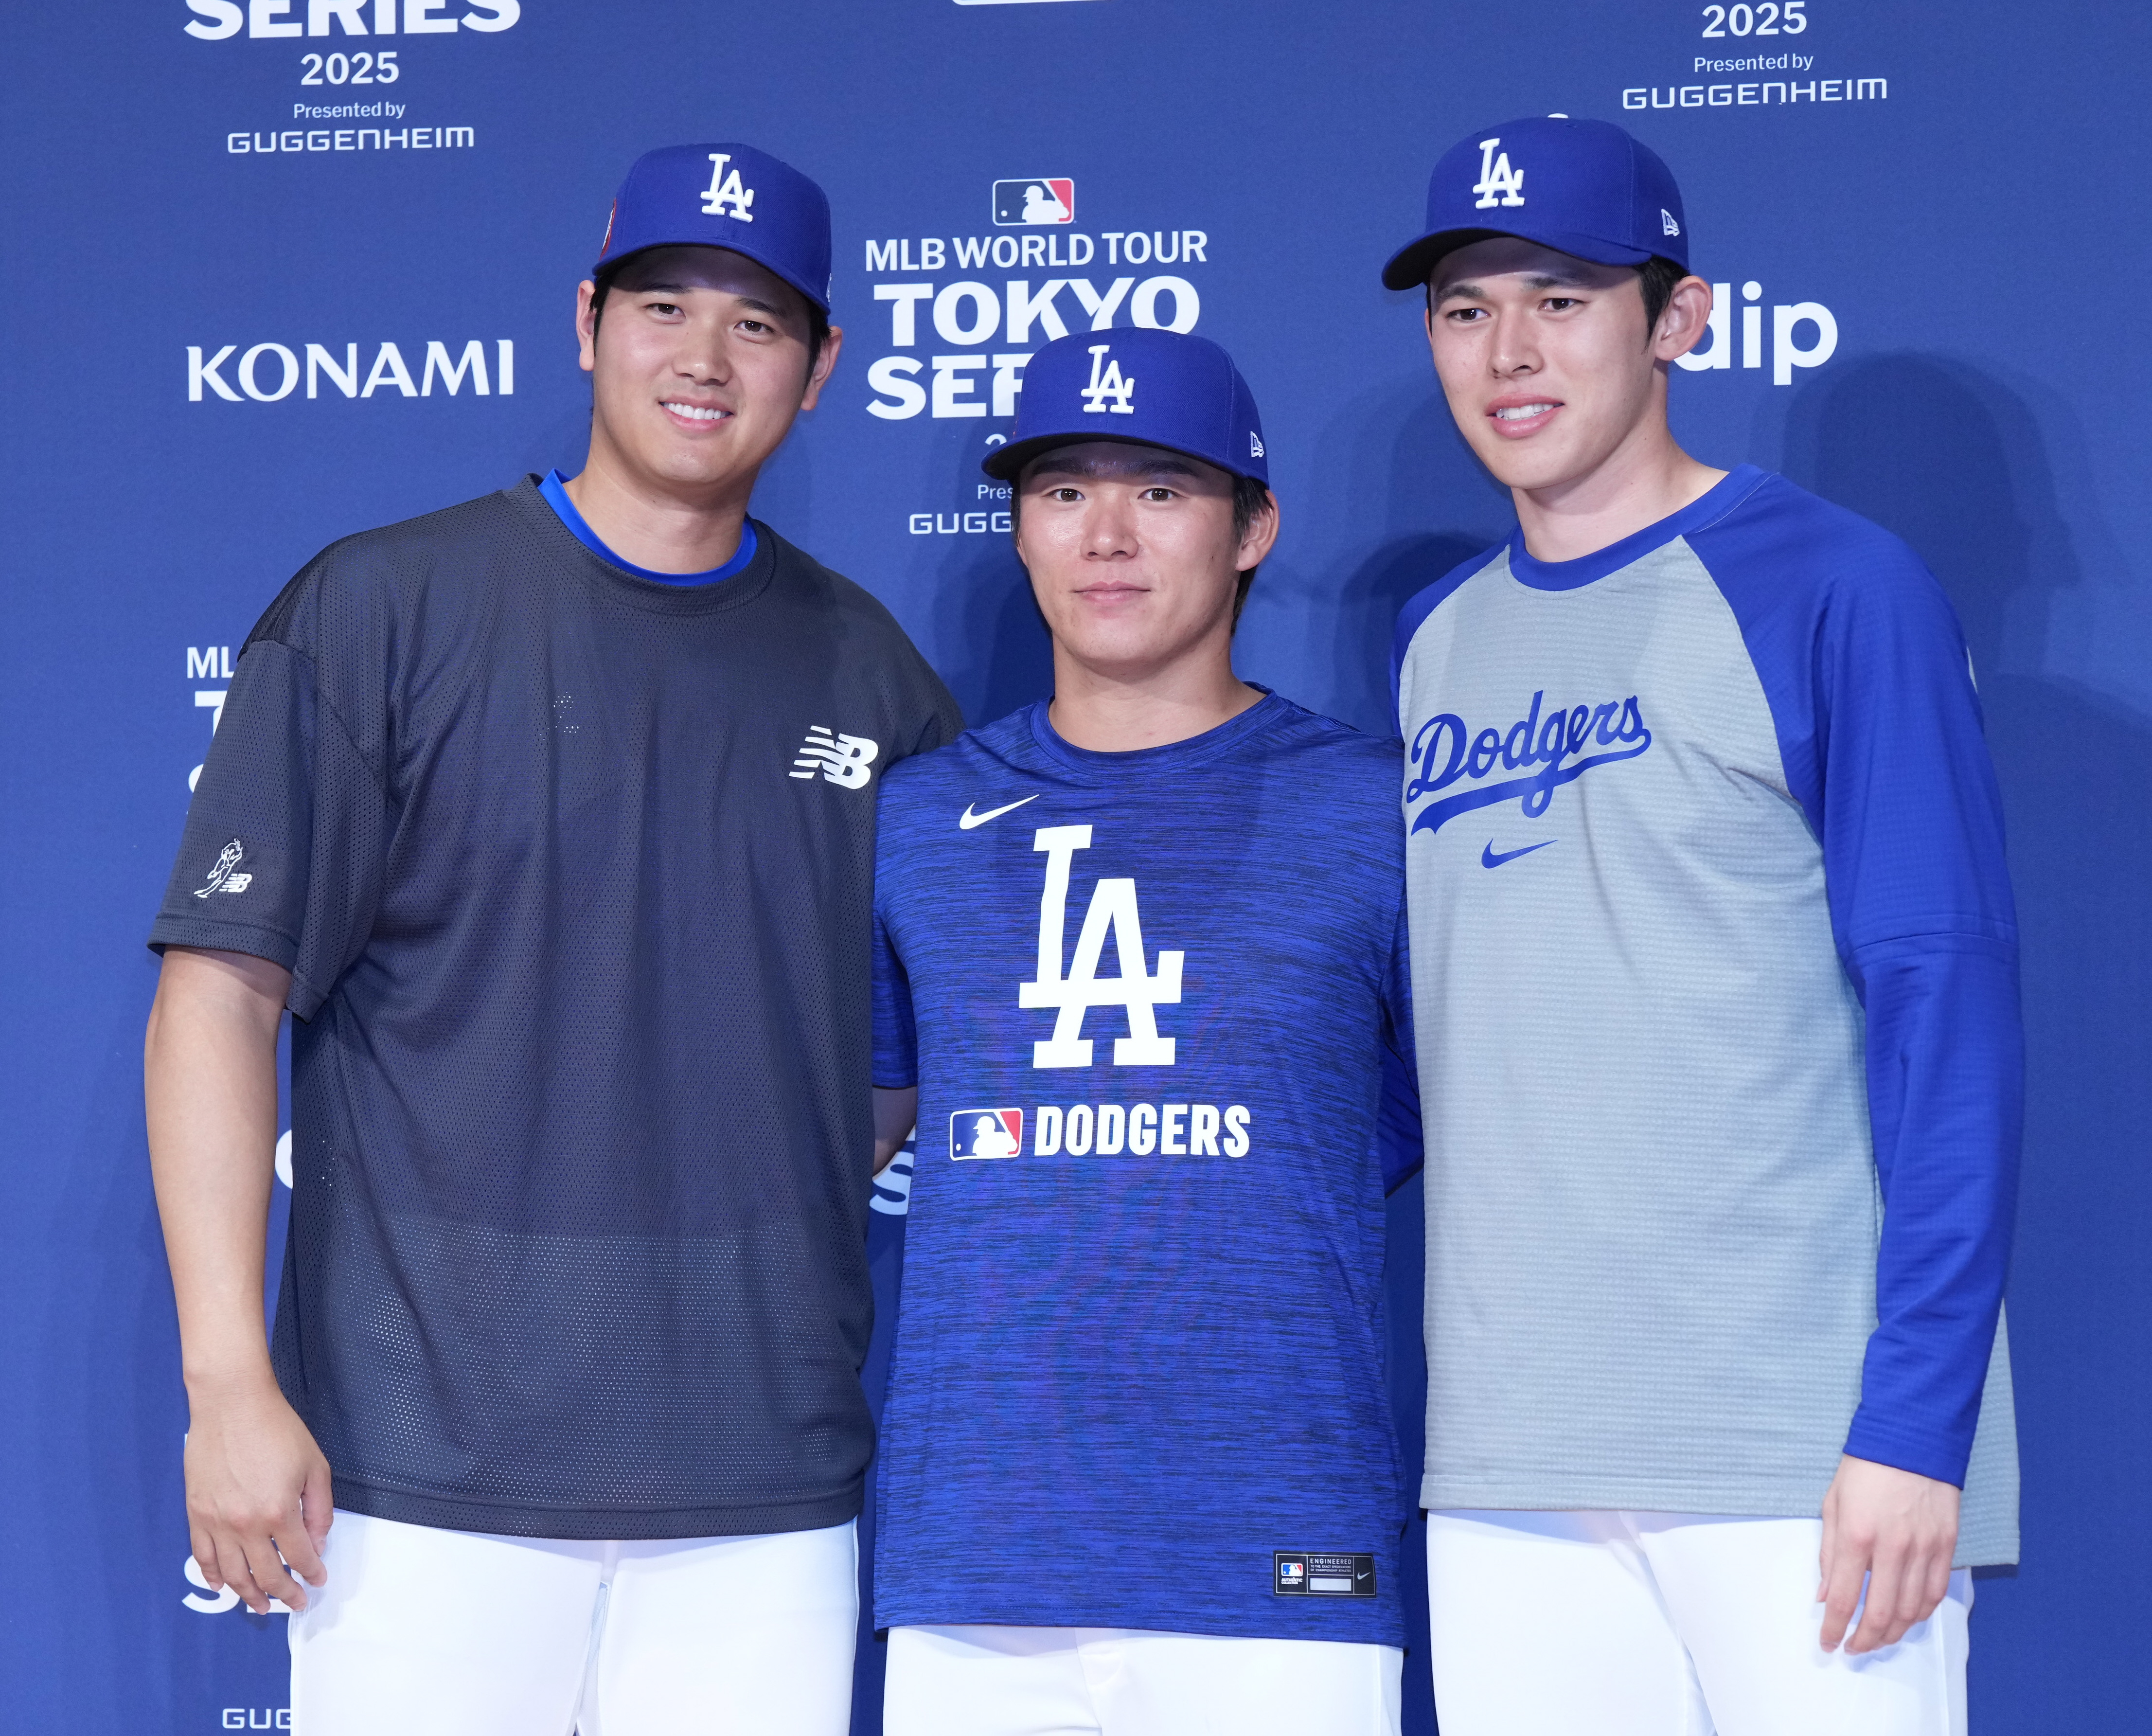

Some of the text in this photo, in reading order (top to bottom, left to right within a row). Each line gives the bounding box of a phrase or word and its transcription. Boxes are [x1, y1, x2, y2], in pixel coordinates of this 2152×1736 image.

[1702, 1, 1807, 38] 2025
[301, 52, 399, 85] 2025
[1694, 53, 1814, 72] Presented by
[294, 101, 406, 119] Presented by
[1623, 78, 1887, 109] GUGGENHEIM
[228, 127, 474, 153] GUGGENHEIM
[700, 153, 754, 223] LA
[1473, 138, 1525, 209] LA
[866, 231, 1208, 271] MLB WORLD TOUR
[873, 276, 1200, 346] TOKYO
[1674, 280, 1838, 386] dip
[186, 340, 514, 402] KONAMI
[1081, 345, 1135, 414] LA
[1406, 690, 1652, 836] Dodgers
[1018, 824, 1185, 1069] LA
[1034, 1103, 1250, 1158] DODGERS
